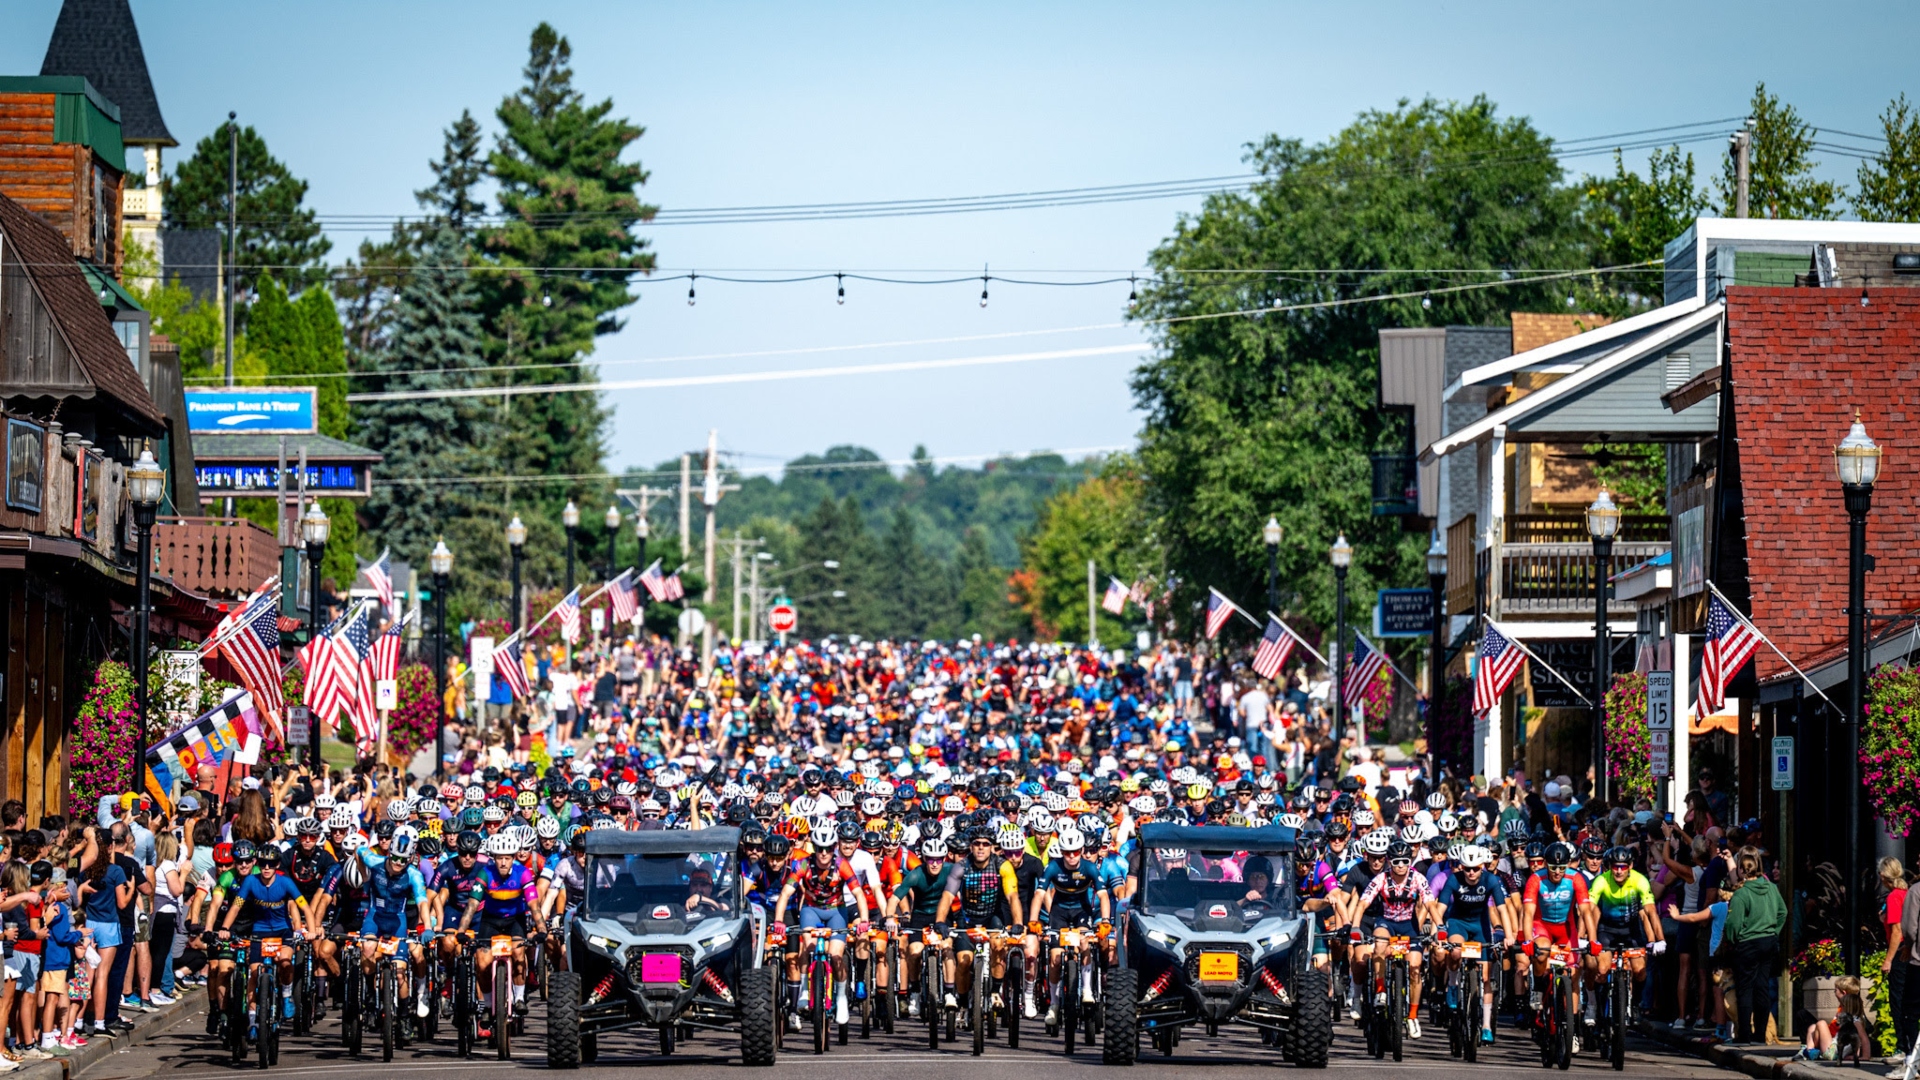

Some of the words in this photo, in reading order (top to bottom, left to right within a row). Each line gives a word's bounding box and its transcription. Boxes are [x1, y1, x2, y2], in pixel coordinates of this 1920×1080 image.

[262, 401, 271, 411] &
[771, 613, 795, 625] STOP
[1649, 677, 1670, 686] SPEED
[1651, 690, 1668, 698] LIMIT
[1652, 703, 1668, 725] 15
[178, 721, 239, 769] OPEN
[1651, 745, 1668, 753] PARKING
